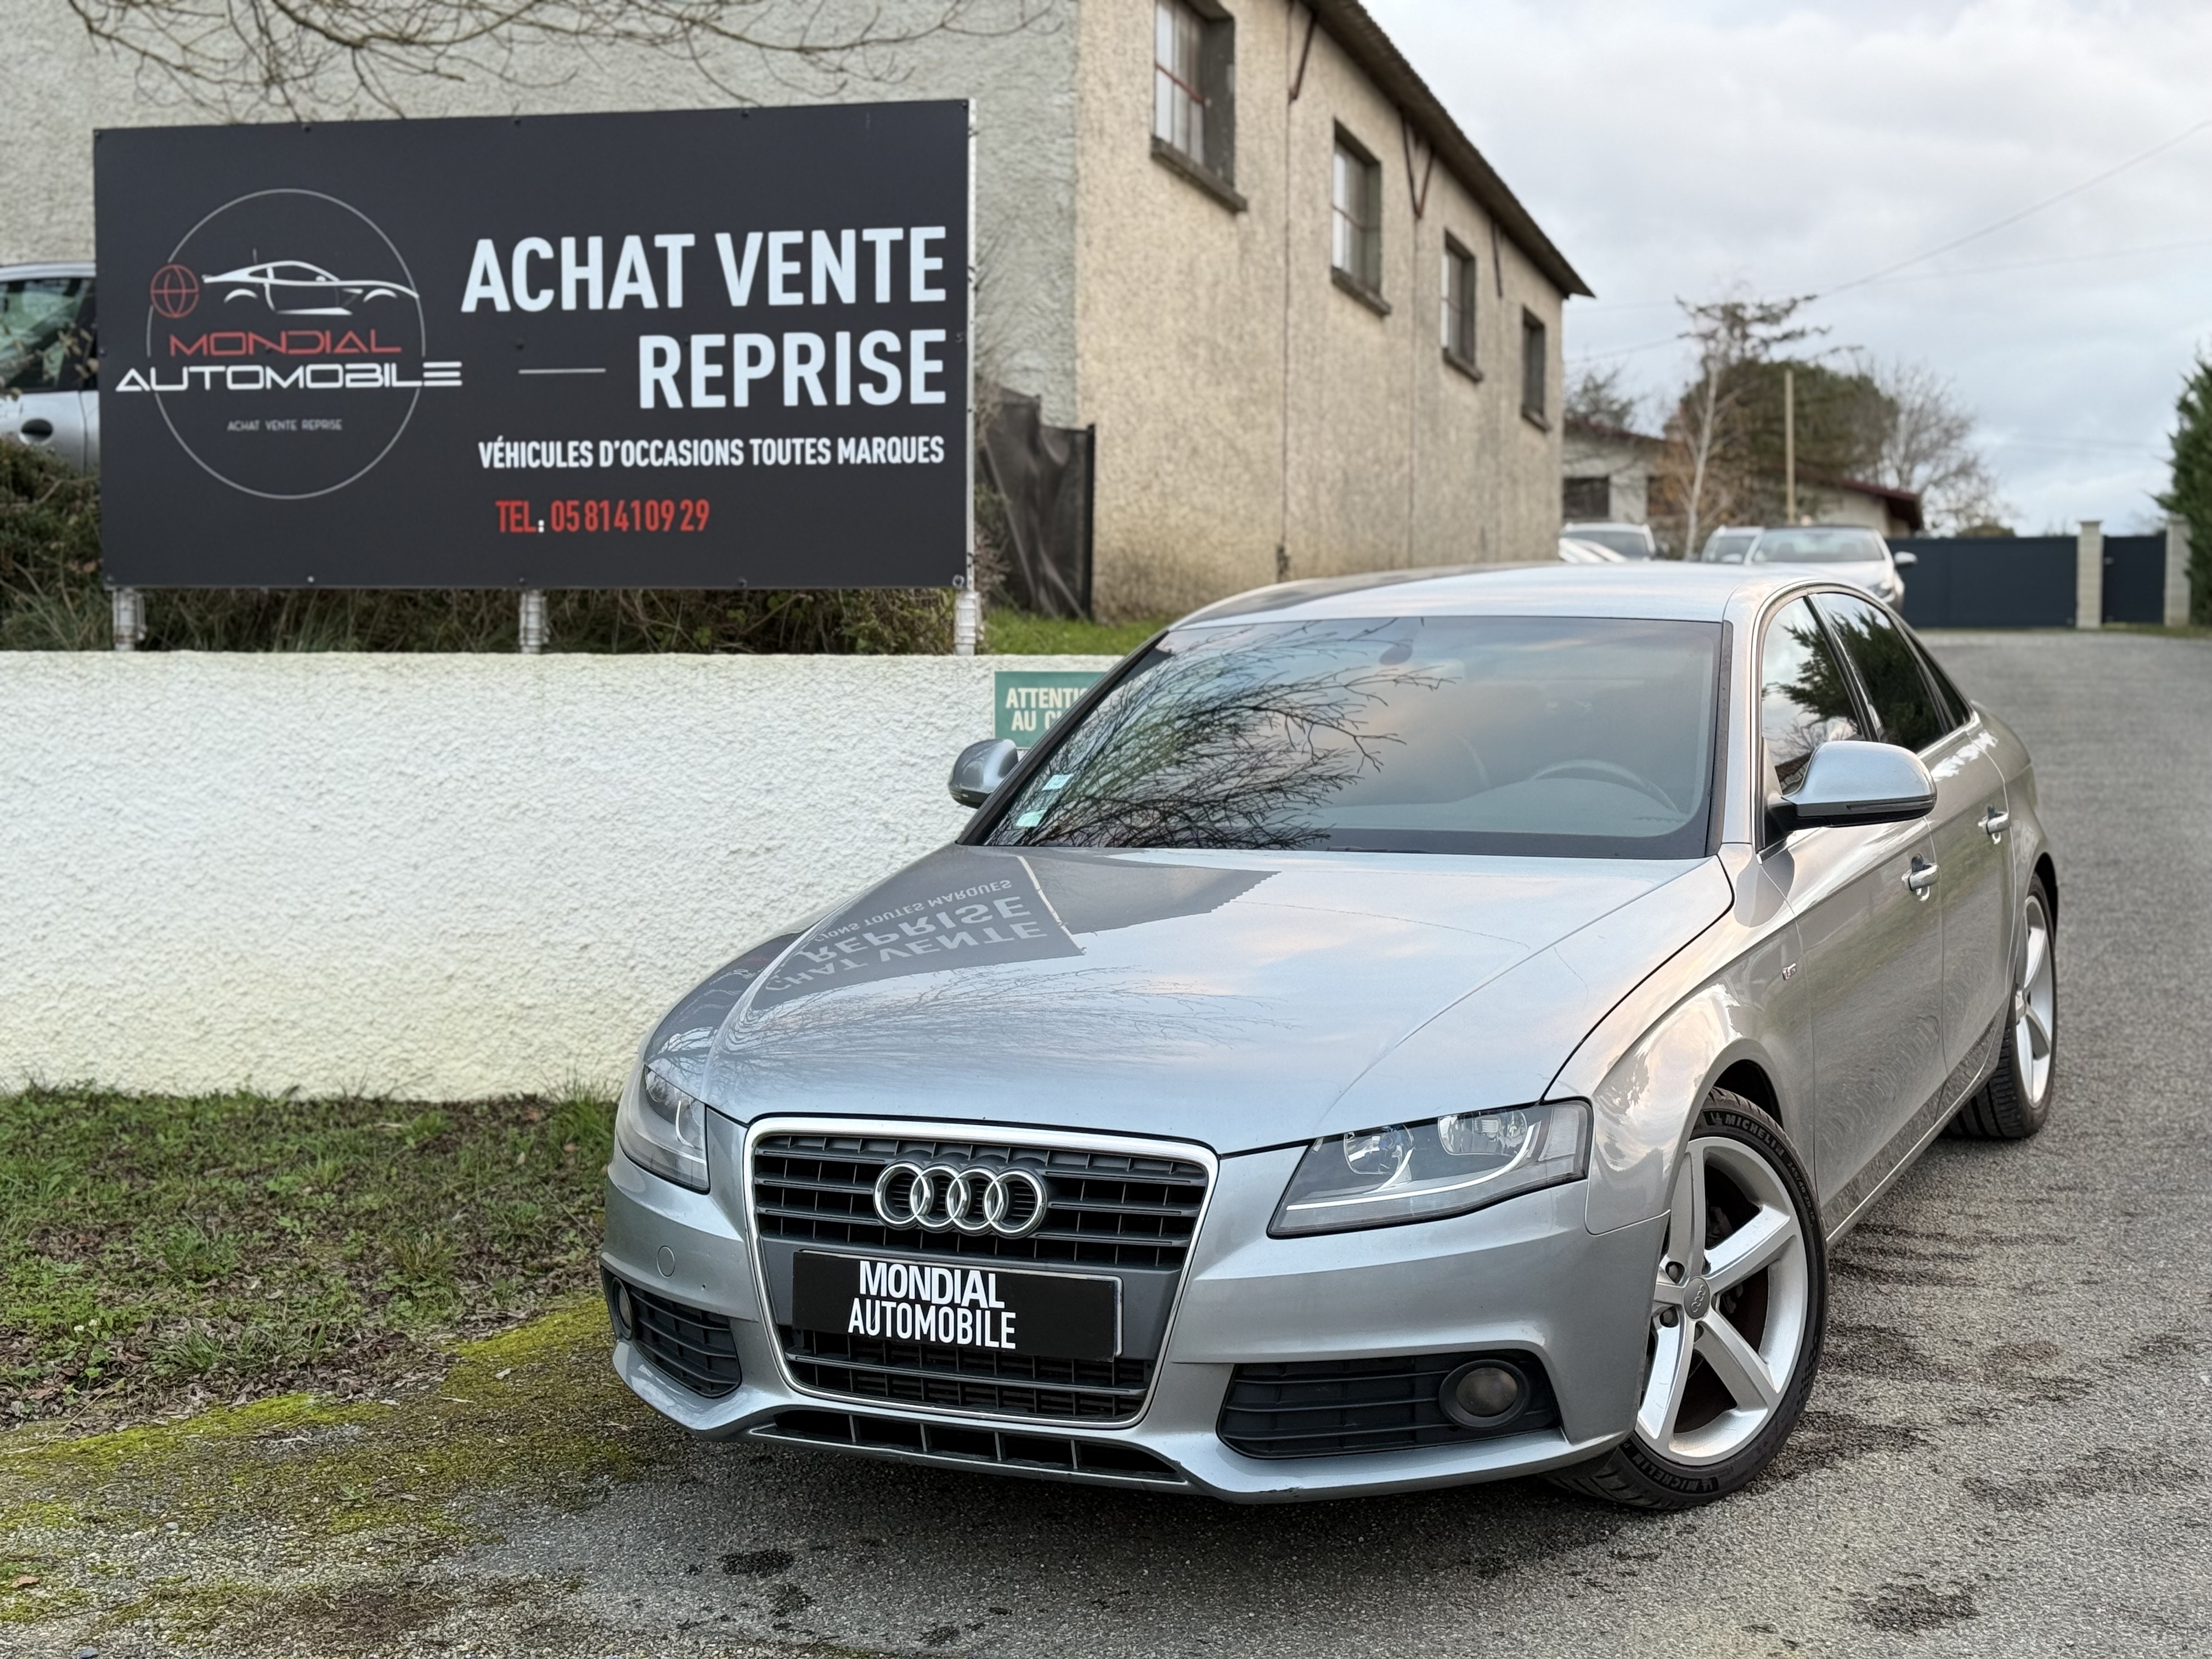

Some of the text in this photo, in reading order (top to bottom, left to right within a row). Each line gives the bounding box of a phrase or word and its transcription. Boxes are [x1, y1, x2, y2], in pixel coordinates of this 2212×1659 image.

[461, 226, 946, 312] ACHAT VENTE
[170, 329, 402, 356] MONDIAL
[116, 362, 462, 392] AUTOMOBILE
[639, 329, 946, 409] REPRISE
[227, 418, 343, 432] ACHAT VENTE REPRISE
[478, 435, 944, 469] VÉHICULES D'OCCASIONS TOUTES MARQUES
[1011, 710, 1036, 731] AU
[1725, 1114, 1785, 1157] MICHELIN
[860, 1260, 1006, 1309] MONDIAL
[848, 1297, 1016, 1350] AUTOMOBILE
[1632, 1453, 1700, 1492] MICHELIN
